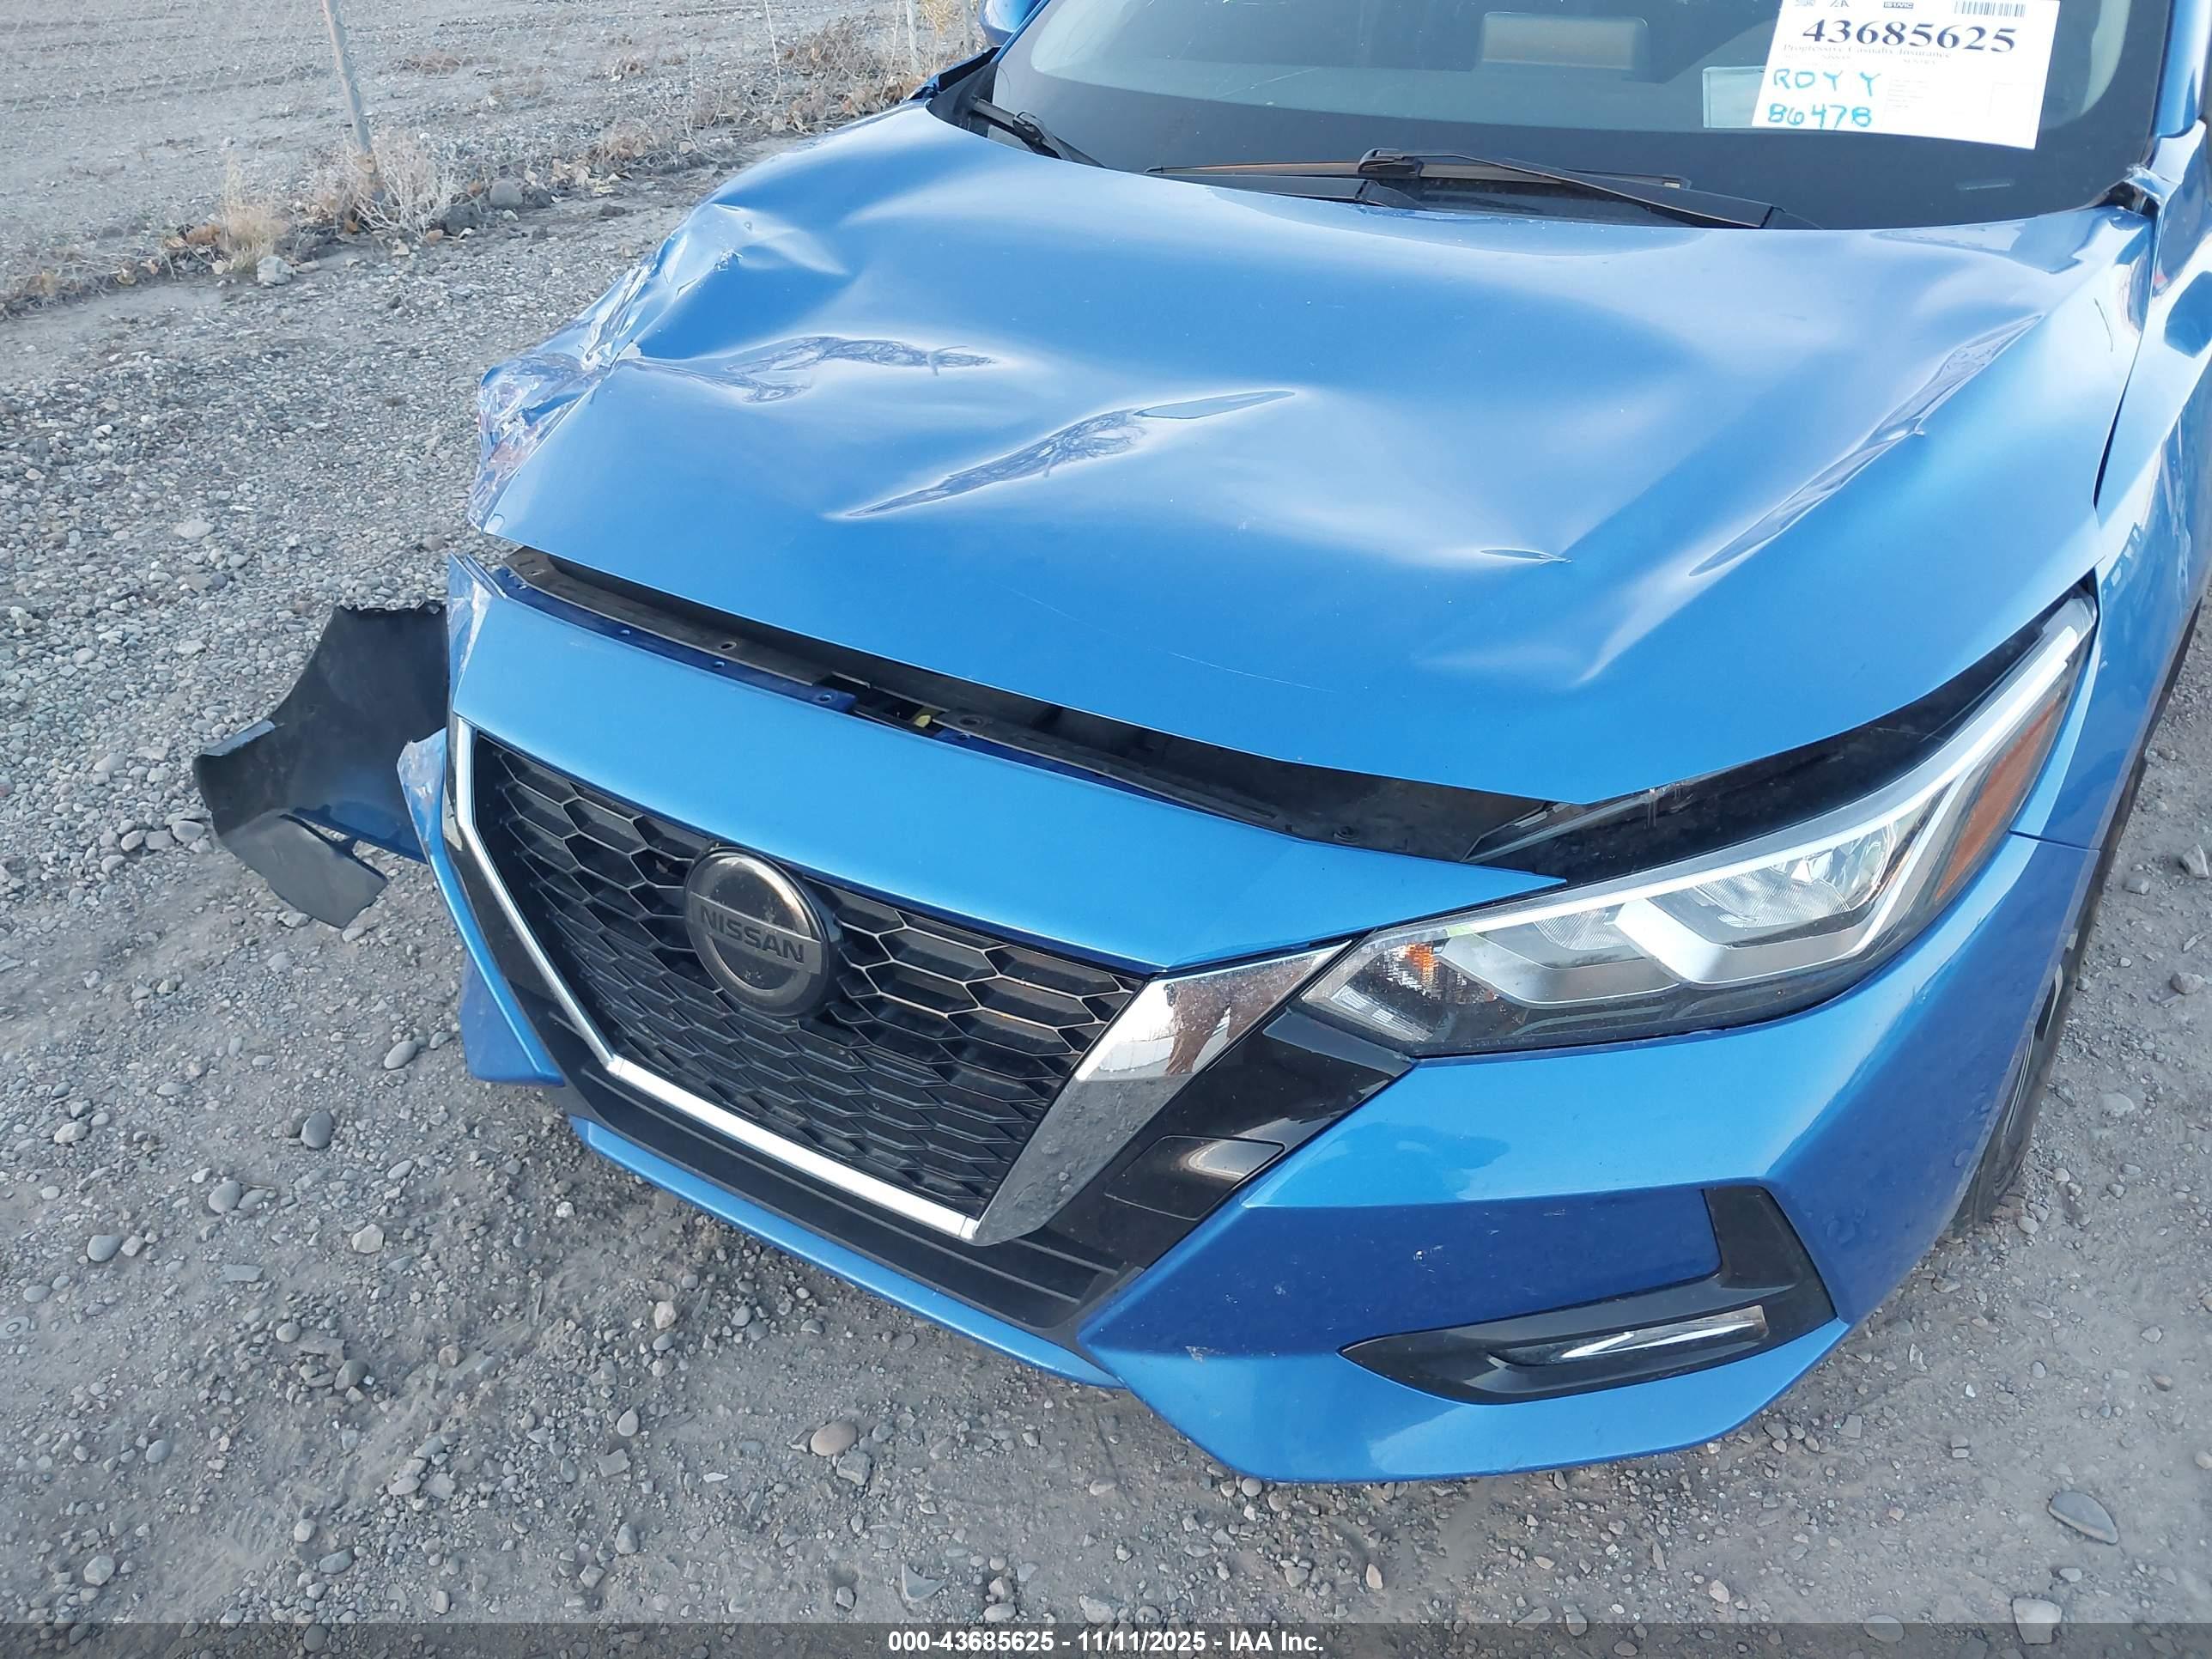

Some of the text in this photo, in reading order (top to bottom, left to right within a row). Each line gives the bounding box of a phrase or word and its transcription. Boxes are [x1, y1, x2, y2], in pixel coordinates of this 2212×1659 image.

[1802, 18, 2017, 52] 43685625
[1859, 70, 1881, 95] Y
[701, 906, 805, 964] NISSAN
